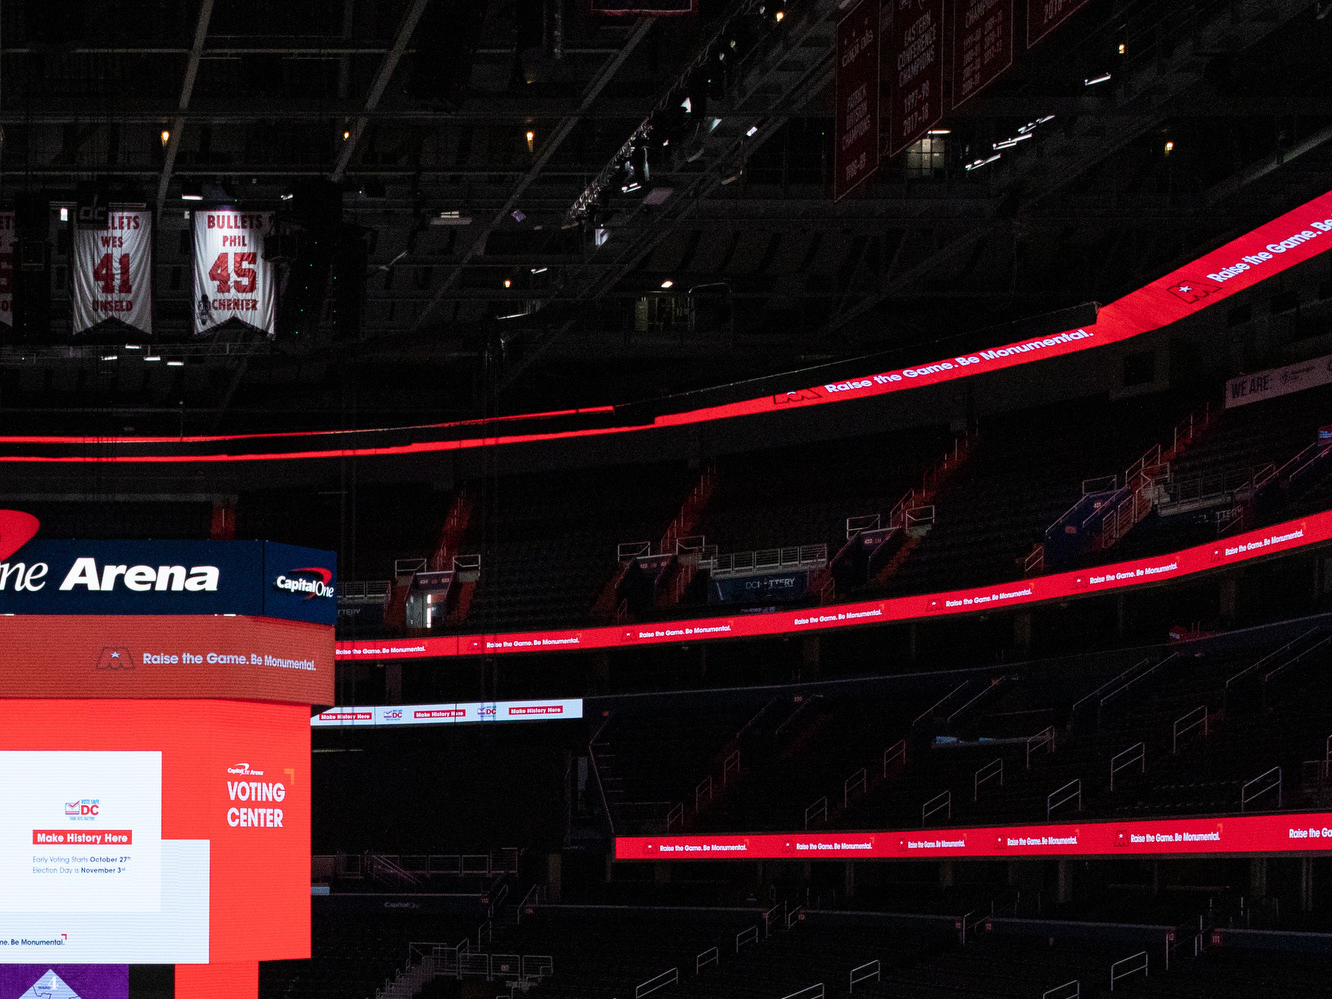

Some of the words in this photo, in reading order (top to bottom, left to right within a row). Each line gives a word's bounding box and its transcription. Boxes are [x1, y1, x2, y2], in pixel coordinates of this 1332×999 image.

[206, 214, 263, 230] BULLETS
[101, 235, 123, 248] WES
[222, 234, 248, 248] PHIL
[93, 252, 133, 294] 41
[208, 251, 257, 294] 45
[92, 299, 134, 312] UNSELD
[211, 298, 258, 312] CHENIER
[824, 377, 873, 394] Raise
[873, 373, 902, 384] the
[902, 360, 959, 379] Game.
[955, 356, 980, 366] Be
[979, 329, 1094, 360] Monumental.
[1231, 379, 1248, 399] WE
[59, 557, 220, 592] Arena
[1089, 576, 1105, 584] Raise
[1105, 574, 1115, 582] the
[1116, 571, 1136, 579] Game.
[1145, 562, 1178, 575] Monumental.
[142, 653, 179, 665] Raise
[181, 653, 203, 665] the
[206, 653, 249, 666] Game.
[250, 654, 263, 666] Be
[264, 654, 317, 671] Monumental.
[227, 781, 286, 803] VOTING
[81, 804, 100, 815] DC
[227, 807, 284, 828] CENTER
[37, 833, 64, 843] Make
[67, 833, 102, 845] History
[104, 833, 128, 843] Here
[33, 856, 48, 864] Early
[49, 856, 70, 864] Voting
[47, 976, 59, 990] 4
